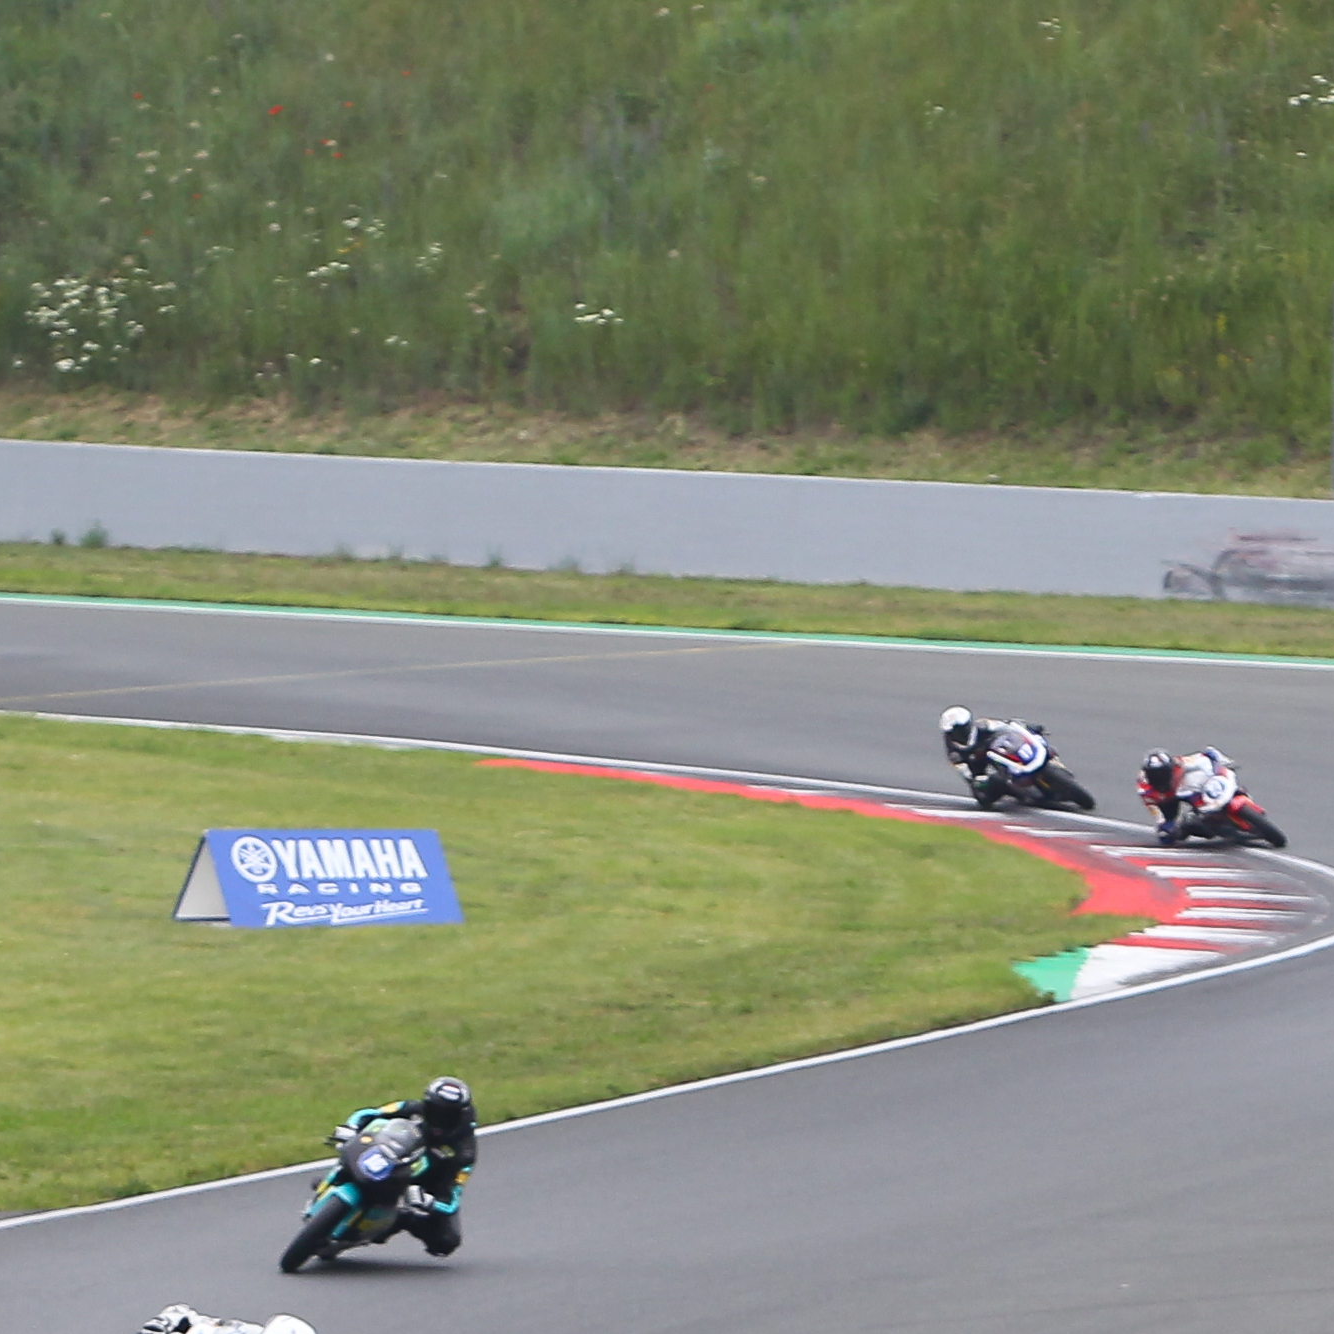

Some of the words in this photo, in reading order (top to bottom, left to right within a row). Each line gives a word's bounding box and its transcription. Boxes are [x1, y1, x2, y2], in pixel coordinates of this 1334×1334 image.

[271, 838, 428, 879] YAMAHA
[257, 882, 422, 894] RACING
[326, 902, 375, 926] Your
